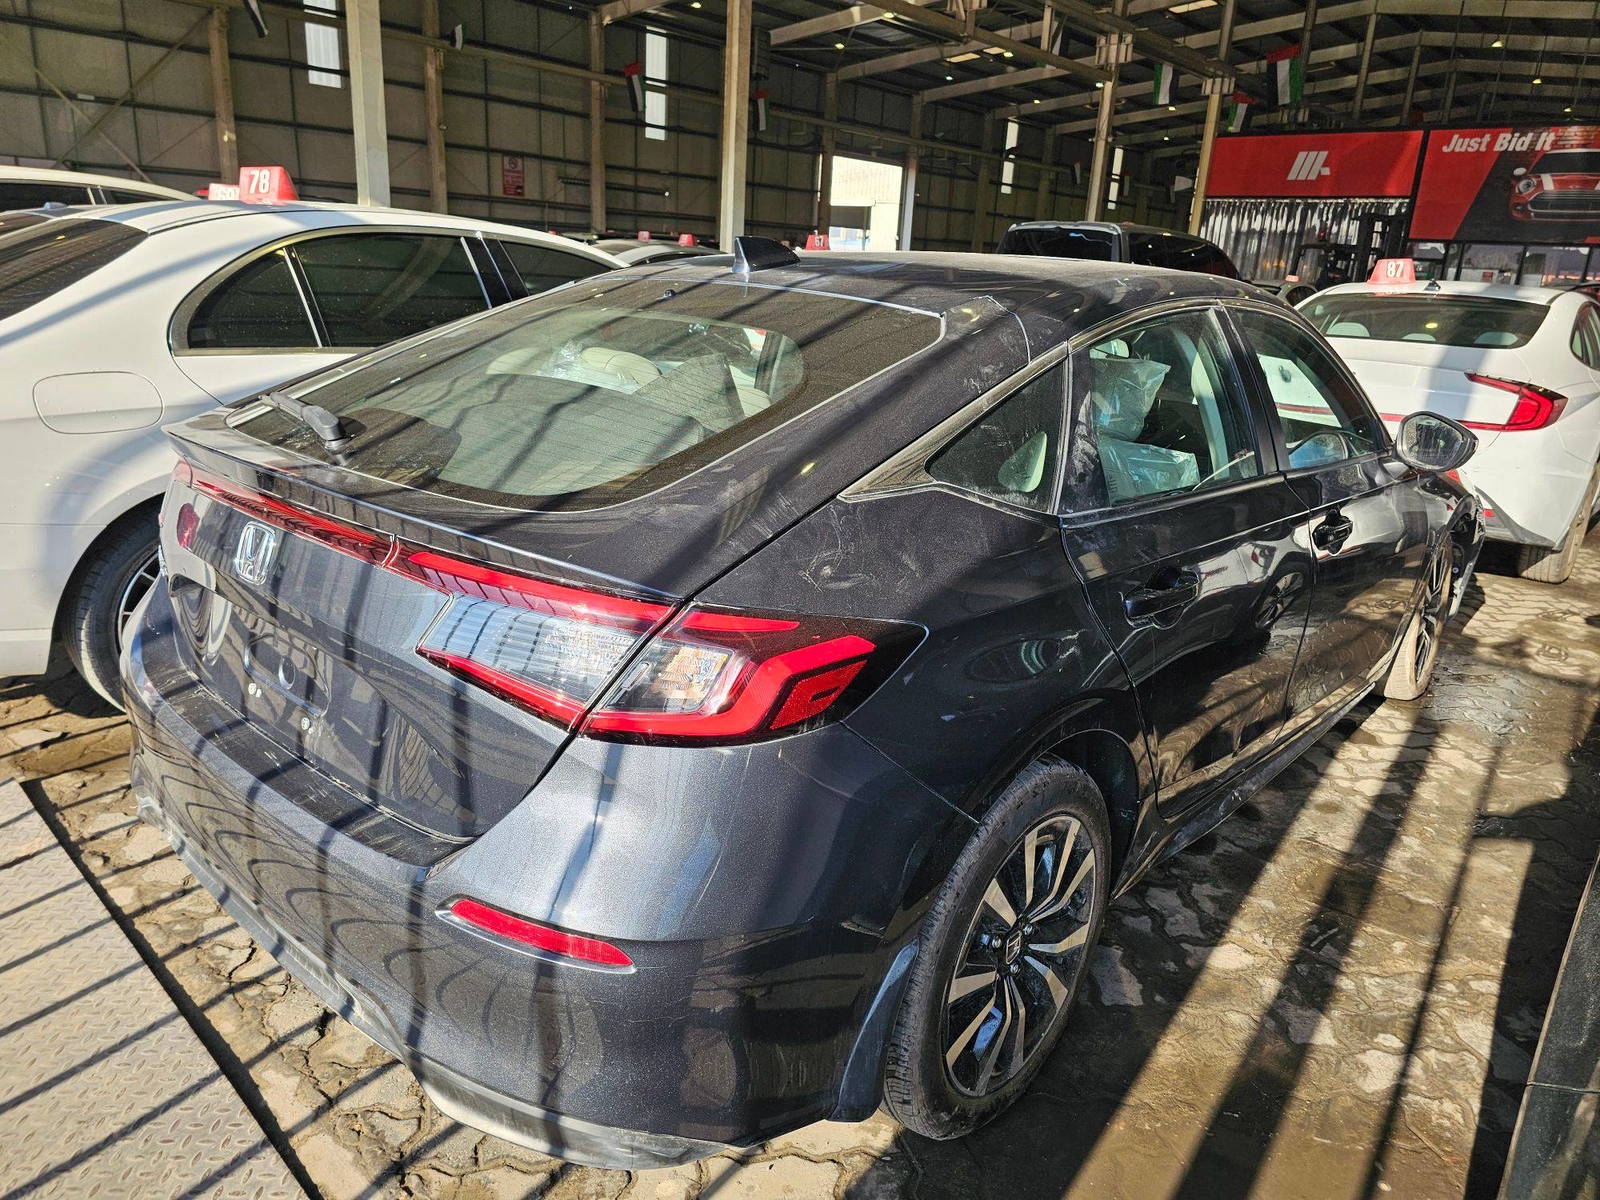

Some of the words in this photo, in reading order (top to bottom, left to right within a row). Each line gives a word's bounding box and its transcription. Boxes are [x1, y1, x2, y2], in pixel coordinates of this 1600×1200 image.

[1442, 133, 1491, 153] Just
[1493, 132, 1534, 152] Bid
[1535, 131, 1556, 152] It
[249, 168, 271, 194] 78
[1387, 260, 1404, 279] 87
